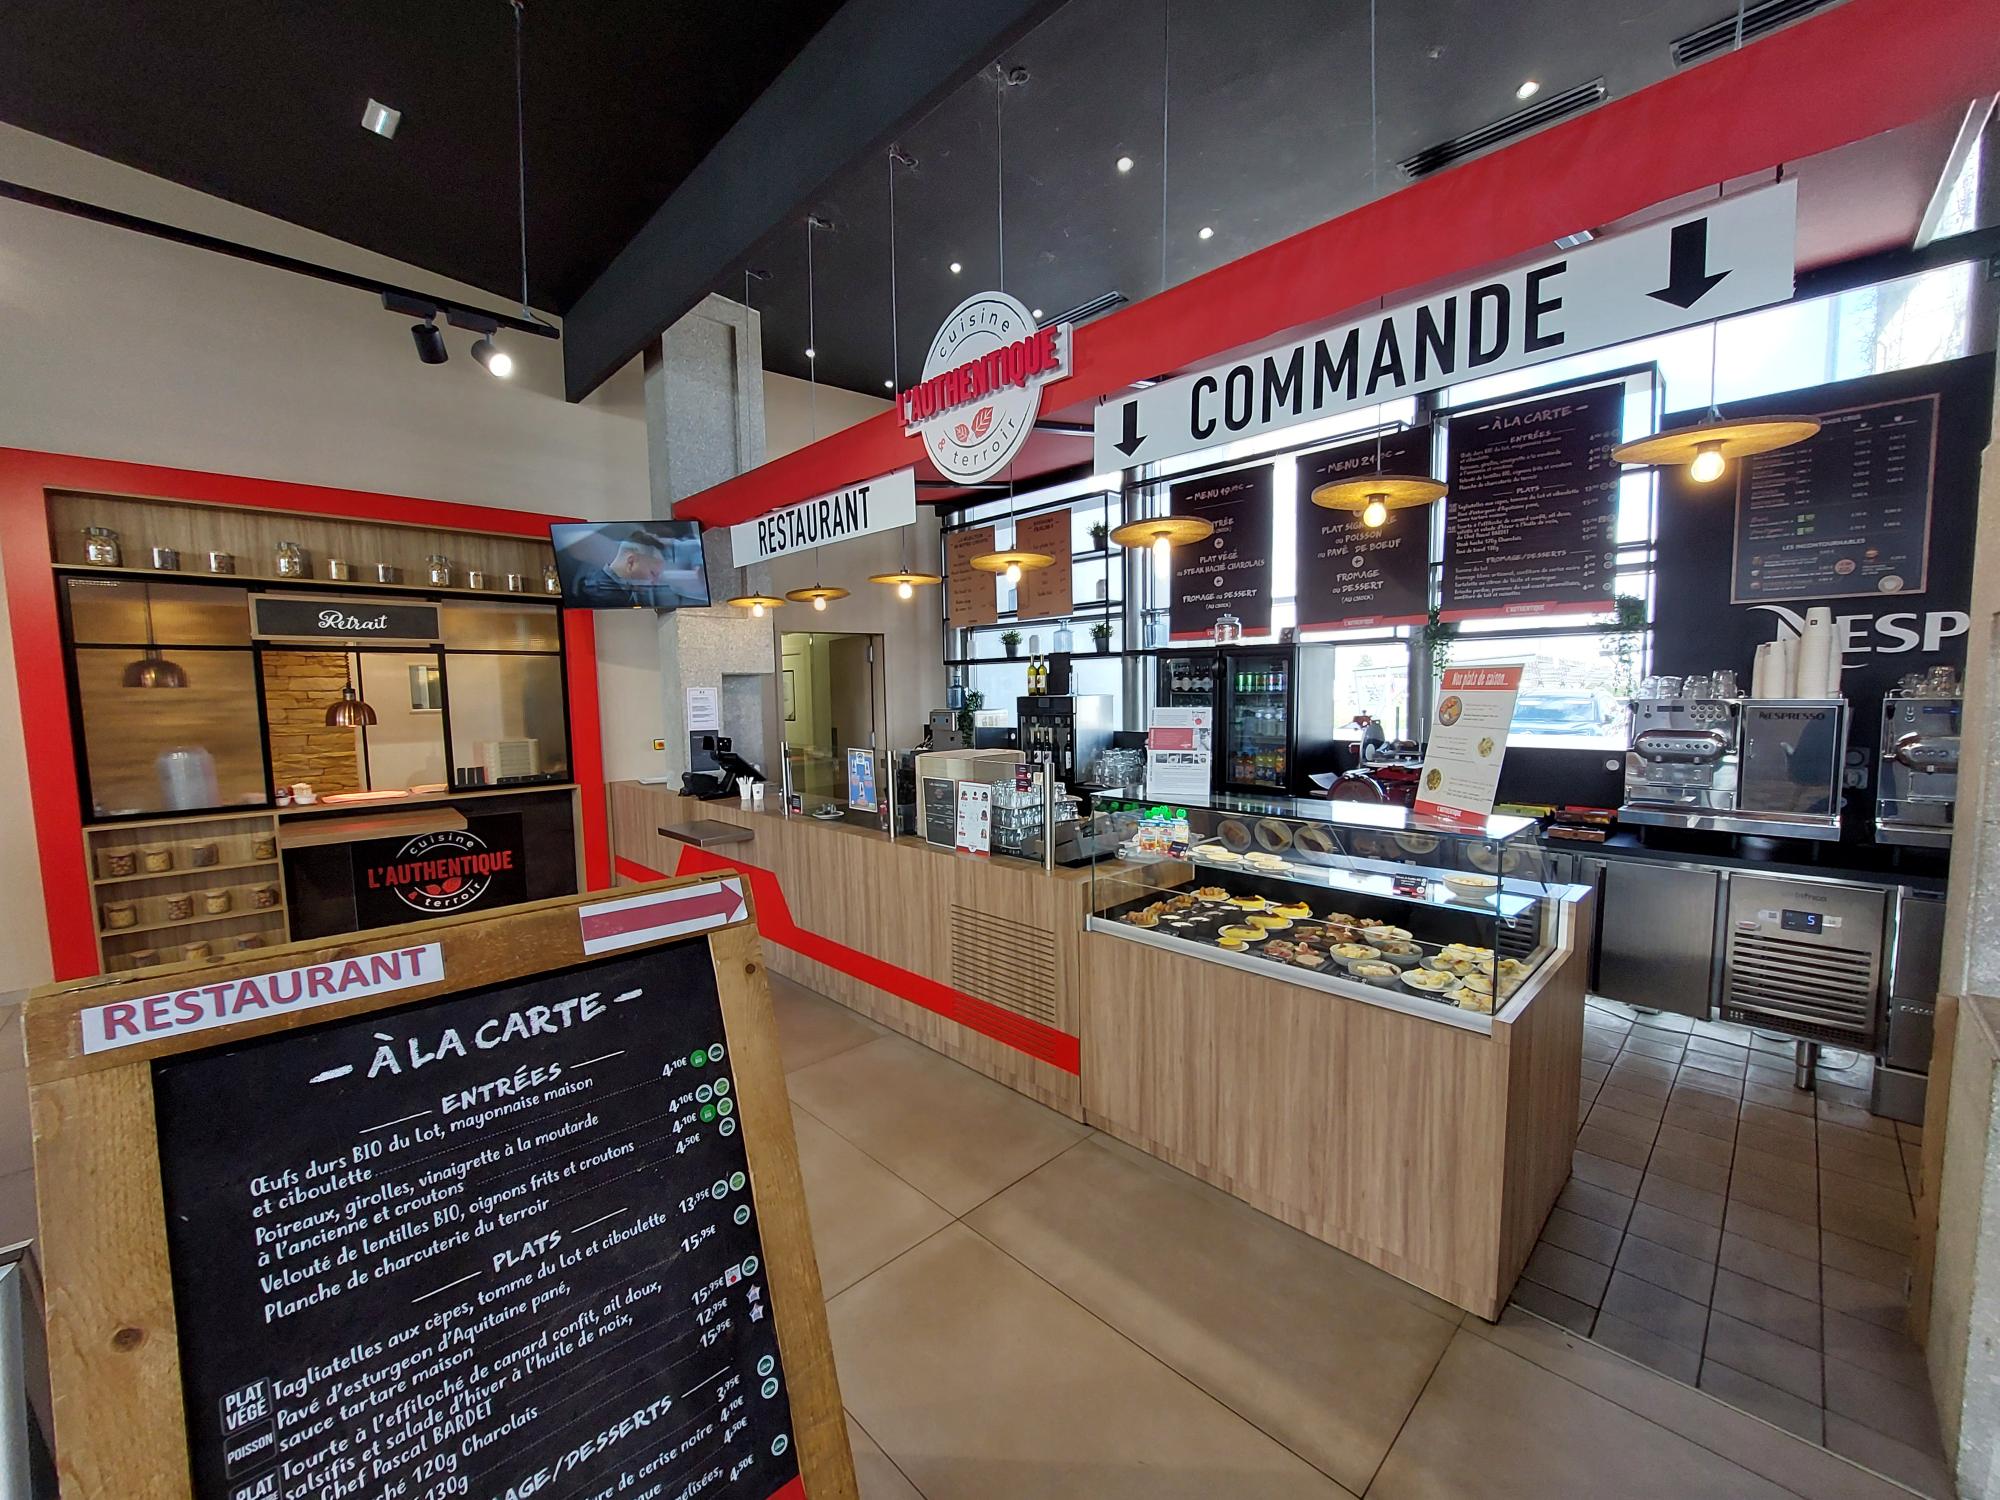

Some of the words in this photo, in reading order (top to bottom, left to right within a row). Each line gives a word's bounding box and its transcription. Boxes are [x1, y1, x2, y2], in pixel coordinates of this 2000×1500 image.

[939, 307, 1010, 358] cuisine
[1190, 260, 1568, 441] COMMANDE
[896, 325, 1060, 428] L'AUTHENTIQUE
[953, 418, 1015, 466] terroir
[1492, 416, 1502, 431] À
[1504, 416, 1521, 429] LA
[1524, 405, 1573, 424] CARTE
[1328, 457, 1359, 474] MENU
[1194, 488, 1219, 501] MENU
[757, 486, 871, 556] RESTAURANT
[1321, 524, 1343, 535] PLAT
[1345, 529, 1382, 543] POISSON
[1183, 567, 1205, 577] STEAK
[1327, 545, 1349, 559] PAVÉ
[1354, 543, 1368, 553] DE
[1336, 569, 1380, 582] FROMAGE
[1182, 593, 1214, 603] FROMAGE
[1223, 589, 1257, 599] DESSERT
[1342, 581, 1384, 593] DESSERT
[318, 610, 388, 630] Retrait
[409, 833, 474, 855] cuisine
[367, 850, 513, 889] L'AUTHENTIQUE
[425, 882, 480, 907] terroir
[103, 946, 428, 1041] RESTAURANT
[366, 1031, 402, 1079] À
[409, 1028, 467, 1070] LA
[476, 992, 607, 1050] CARTE
[441, 1060, 562, 1115] ENTRÉES
[250, 1169, 299, 1197] Œufs
[305, 1156, 347, 1180] durs
[352, 1140, 382, 1163] BIO
[388, 1134, 410, 1153] du
[449, 1092, 541, 1133] mayonnaise
[544, 1077, 594, 1103] maison
[252, 1199, 273, 1218] et
[278, 1167, 372, 1209] ciboulette
[256, 1207, 340, 1246] Poireaux,
[345, 1182, 415, 1219] girolles,
[419, 1148, 501, 1187] vinaigrette
[504, 1143, 514, 1157] à
[516, 1137, 532, 1154] la
[535, 1114, 599, 1146] moutarde
[257, 1251, 270, 1267] à
[275, 1217, 368, 1260] l'ancienne
[373, 1206, 390, 1224] et
[394, 1181, 464, 1218] croutons
[260, 1256, 331, 1294] Velouté
[336, 1246, 358, 1266] de
[362, 1220, 429, 1255] lentilles
[433, 1204, 465, 1228] BIO,
[468, 1181, 527, 1215] oignons
[530, 1166, 560, 1192] frits
[563, 1160, 576, 1177] et
[579, 1142, 634, 1171] croutons
[264, 1282, 341, 1324] Planche
[347, 1269, 369, 1290] de
[374, 1231, 470, 1279] charcuterie
[474, 1219, 495, 1238] du
[497, 1197, 549, 1227] terroir
[492, 1230, 562, 1273] PLATS
[272, 1341, 383, 1400] Tagliatelles
[388, 1324, 420, 1348] aux
[425, 1302, 474, 1331] cèpes,
[478, 1273, 533, 1306] tomme
[537, 1261, 556, 1280] du
[585, 1241, 599, 1257] et
[602, 1212, 667, 1249] ciboulette
[277, 1400, 320, 1430] Pavé
[326, 1347, 433, 1406] d'esturgeon
[437, 1301, 528, 1352] d'Aquitaine
[531, 1281, 572, 1313] pané,
[224, 1381, 264, 1413] PLAT
[279, 1417, 334, 1452] sauce
[340, 1381, 407, 1421] tartare
[412, 1347, 474, 1386] maison
[281, 1439, 349, 1481] Tourte
[355, 1427, 367, 1444] à
[372, 1376, 464, 1434] l'effiloché
[469, 1364, 489, 1383] de
[493, 1332, 547, 1372] canard
[552, 1311, 600, 1341] confit,
[603, 1295, 621, 1316] ail
[624, 1281, 662, 1305] doux,
[225, 1397, 268, 1431] VÉGÉ
[285, 1456, 356, 1500] salsifis
[362, 1440, 381, 1461] et
[386, 1407, 443, 1450] salade
[450, 1377, 506, 1414] d'hiver
[511, 1367, 522, 1383] à
[525, 1344, 574, 1375] l'huile
[578, 1330, 594, 1348] de
[599, 1312, 633, 1338] noix,
[227, 1433, 273, 1464] POISSON
[320, 1466, 367, 1500] Chef
[372, 1436, 428, 1479] Pascal
[432, 1399, 493, 1445] BARDET
[411, 1453, 457, 1483] 120g
[462, 1407, 538, 1457] Charolais
[618, 1471, 635, 1493] de
[639, 1448, 677, 1479] cerise
[681, 1423, 713, 1453] noire
[235, 1474, 276, 1500] PLAT
[425, 1475, 468, 1500] 130g
